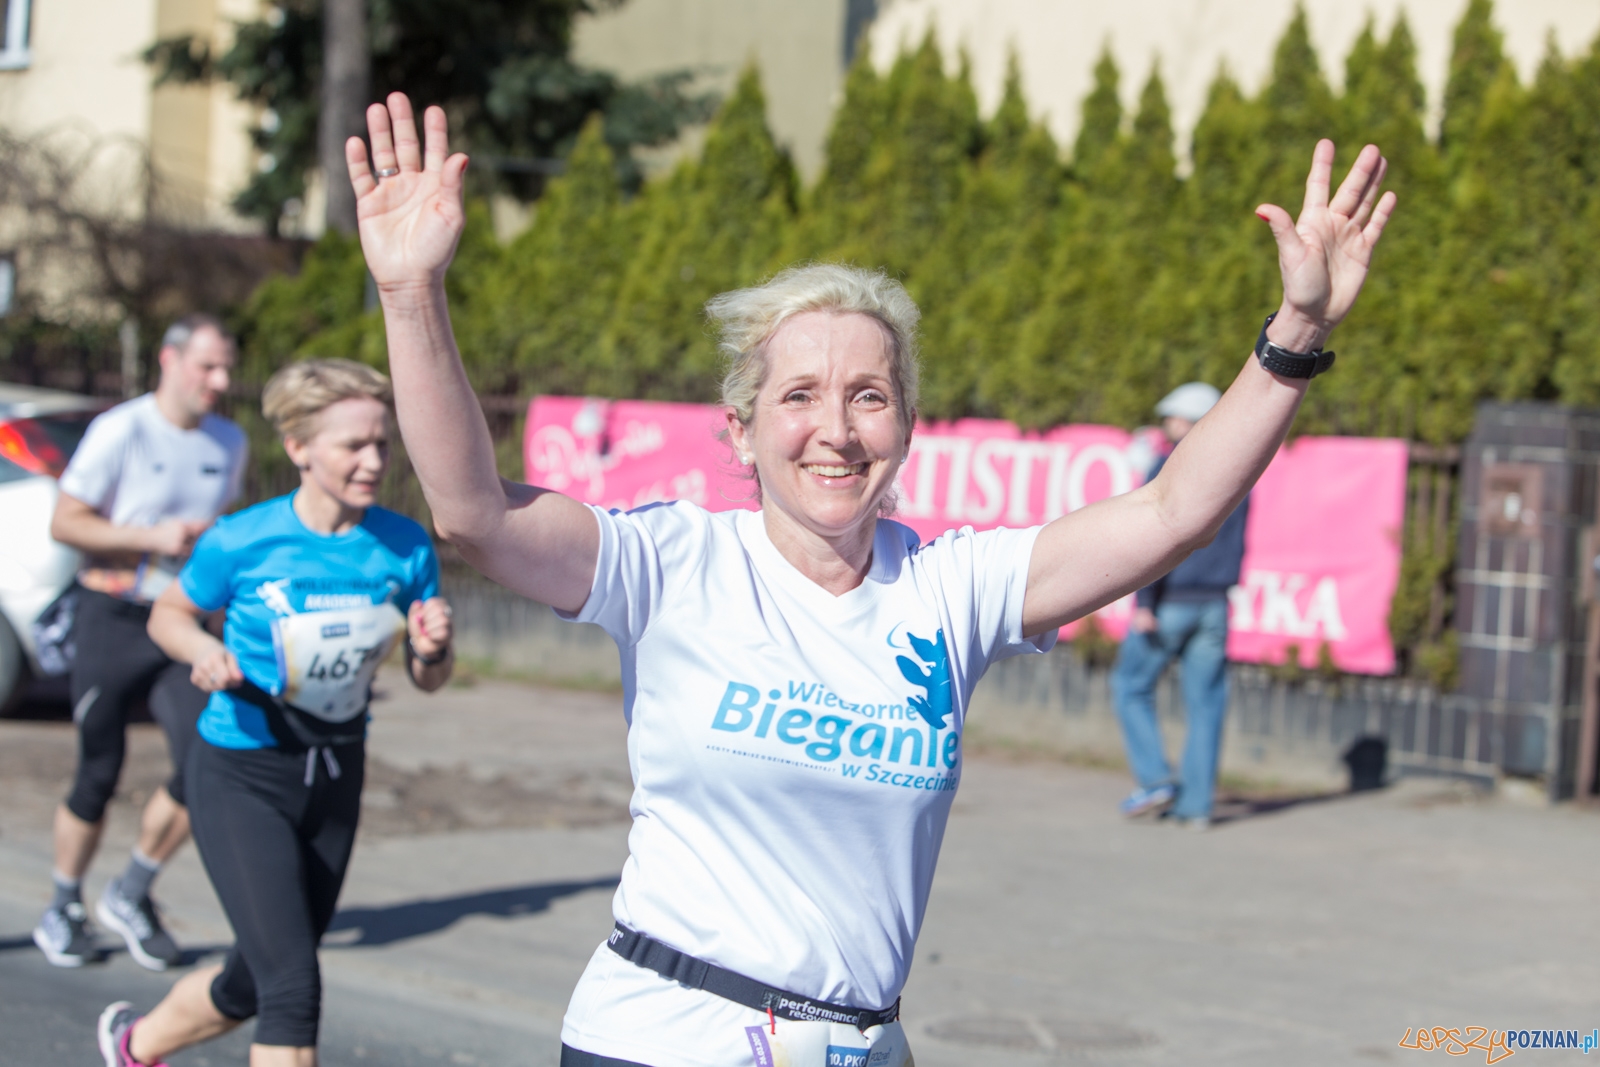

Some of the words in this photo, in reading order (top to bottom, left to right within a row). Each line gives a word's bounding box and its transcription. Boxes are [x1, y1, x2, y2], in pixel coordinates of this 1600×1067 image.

[1227, 568, 1348, 640] YKA
[788, 680, 917, 721] Wieczorne
[711, 681, 959, 770] Bieganie
[841, 763, 860, 778] w
[865, 763, 957, 792] Szczecinie
[779, 998, 858, 1024] performance
[829, 1052, 843, 1067] 10.
[844, 1054, 867, 1067] PKO
